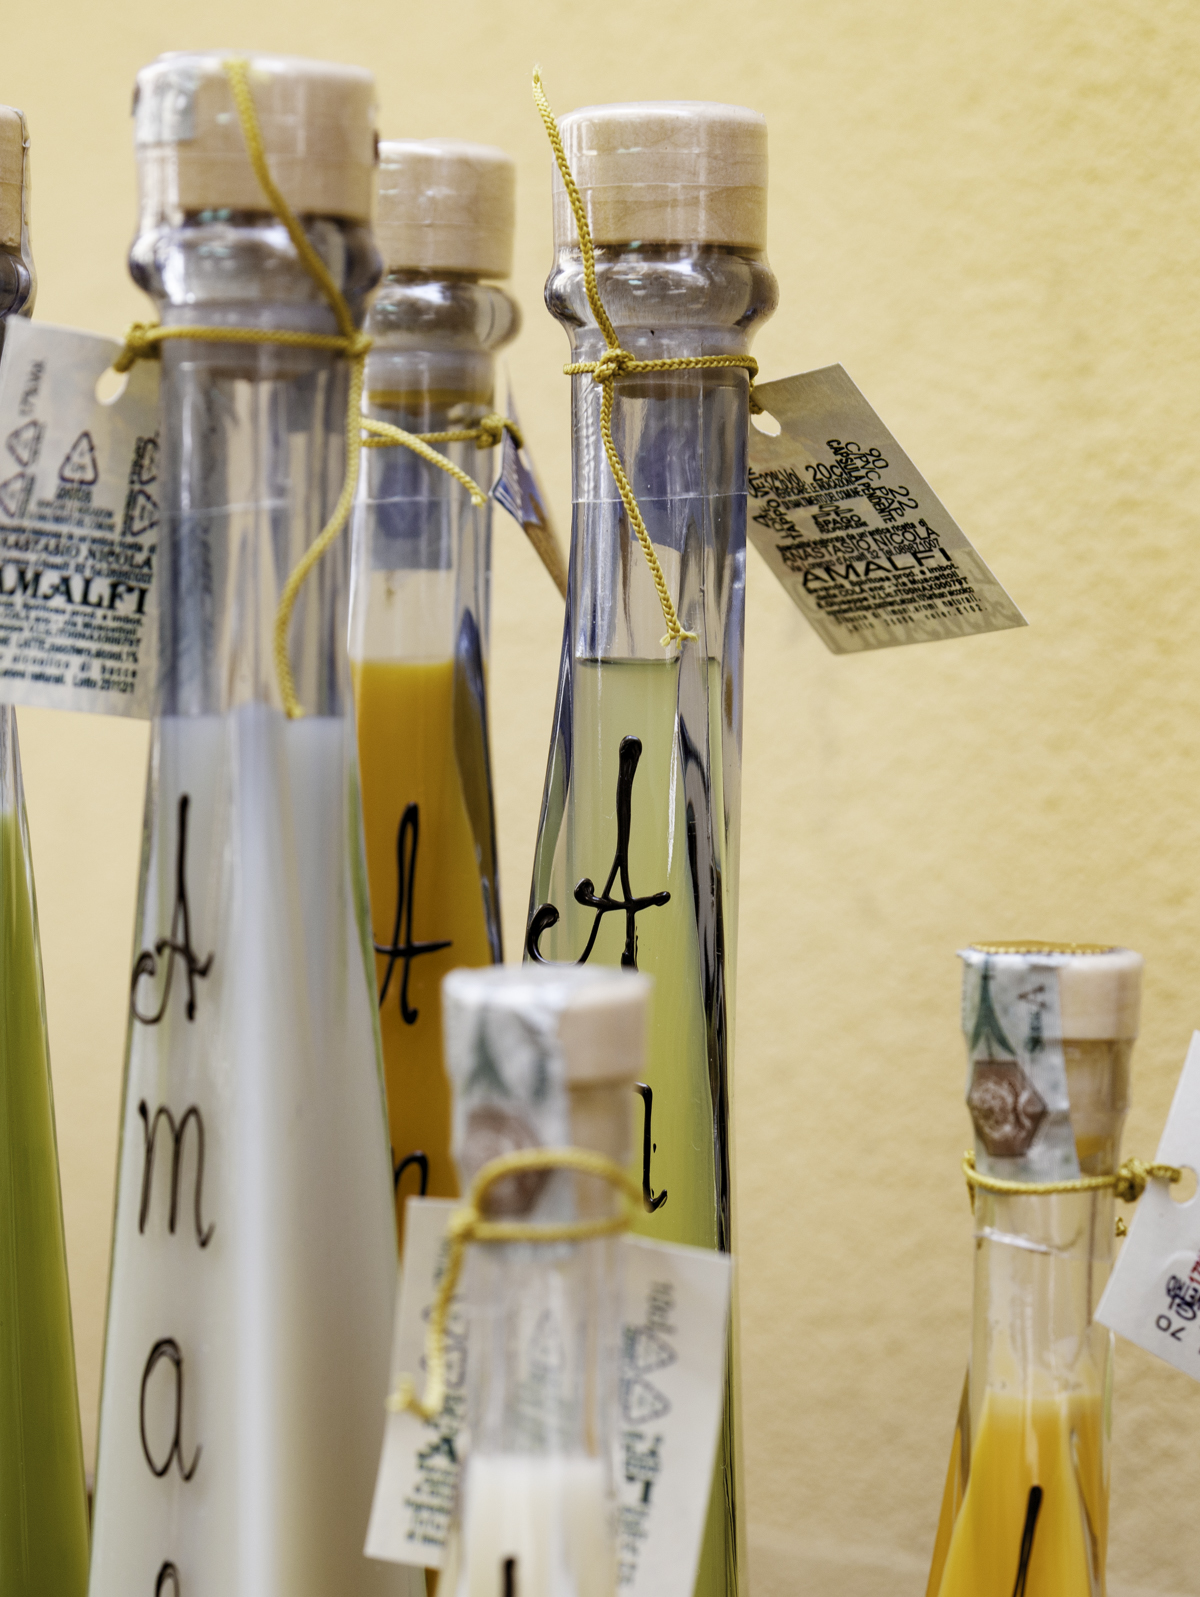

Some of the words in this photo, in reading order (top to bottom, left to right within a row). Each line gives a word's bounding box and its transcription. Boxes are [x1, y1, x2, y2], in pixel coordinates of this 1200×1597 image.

[805, 459, 849, 482] 20cl
[826, 439, 866, 483] CAPSULA
[845, 442, 882, 482] C/PVC
[865, 447, 889, 470] 90
[858, 482, 893, 525] PENDENTE
[874, 485, 905, 520] PAP
[888, 485, 919, 512] 22
[766, 499, 803, 541] TAPPO
[845, 532, 857, 540] da
[891, 522, 917, 533] ricetta
[918, 518, 929, 527] di
[781, 539, 871, 563] ANASTASIO
[872, 527, 941, 550] NICOLA
[869, 549, 882, 559] 32
[879, 538, 941, 557] Tel.089871007
[803, 547, 952, 586] AMALFI
[892, 570, 918, 581] prod.
[838, 586, 868, 598] COLA
[910, 570, 960, 585] Muscettoli
[131, 794, 214, 1597] Ama
[1155, 1313, 1186, 1342] 70
